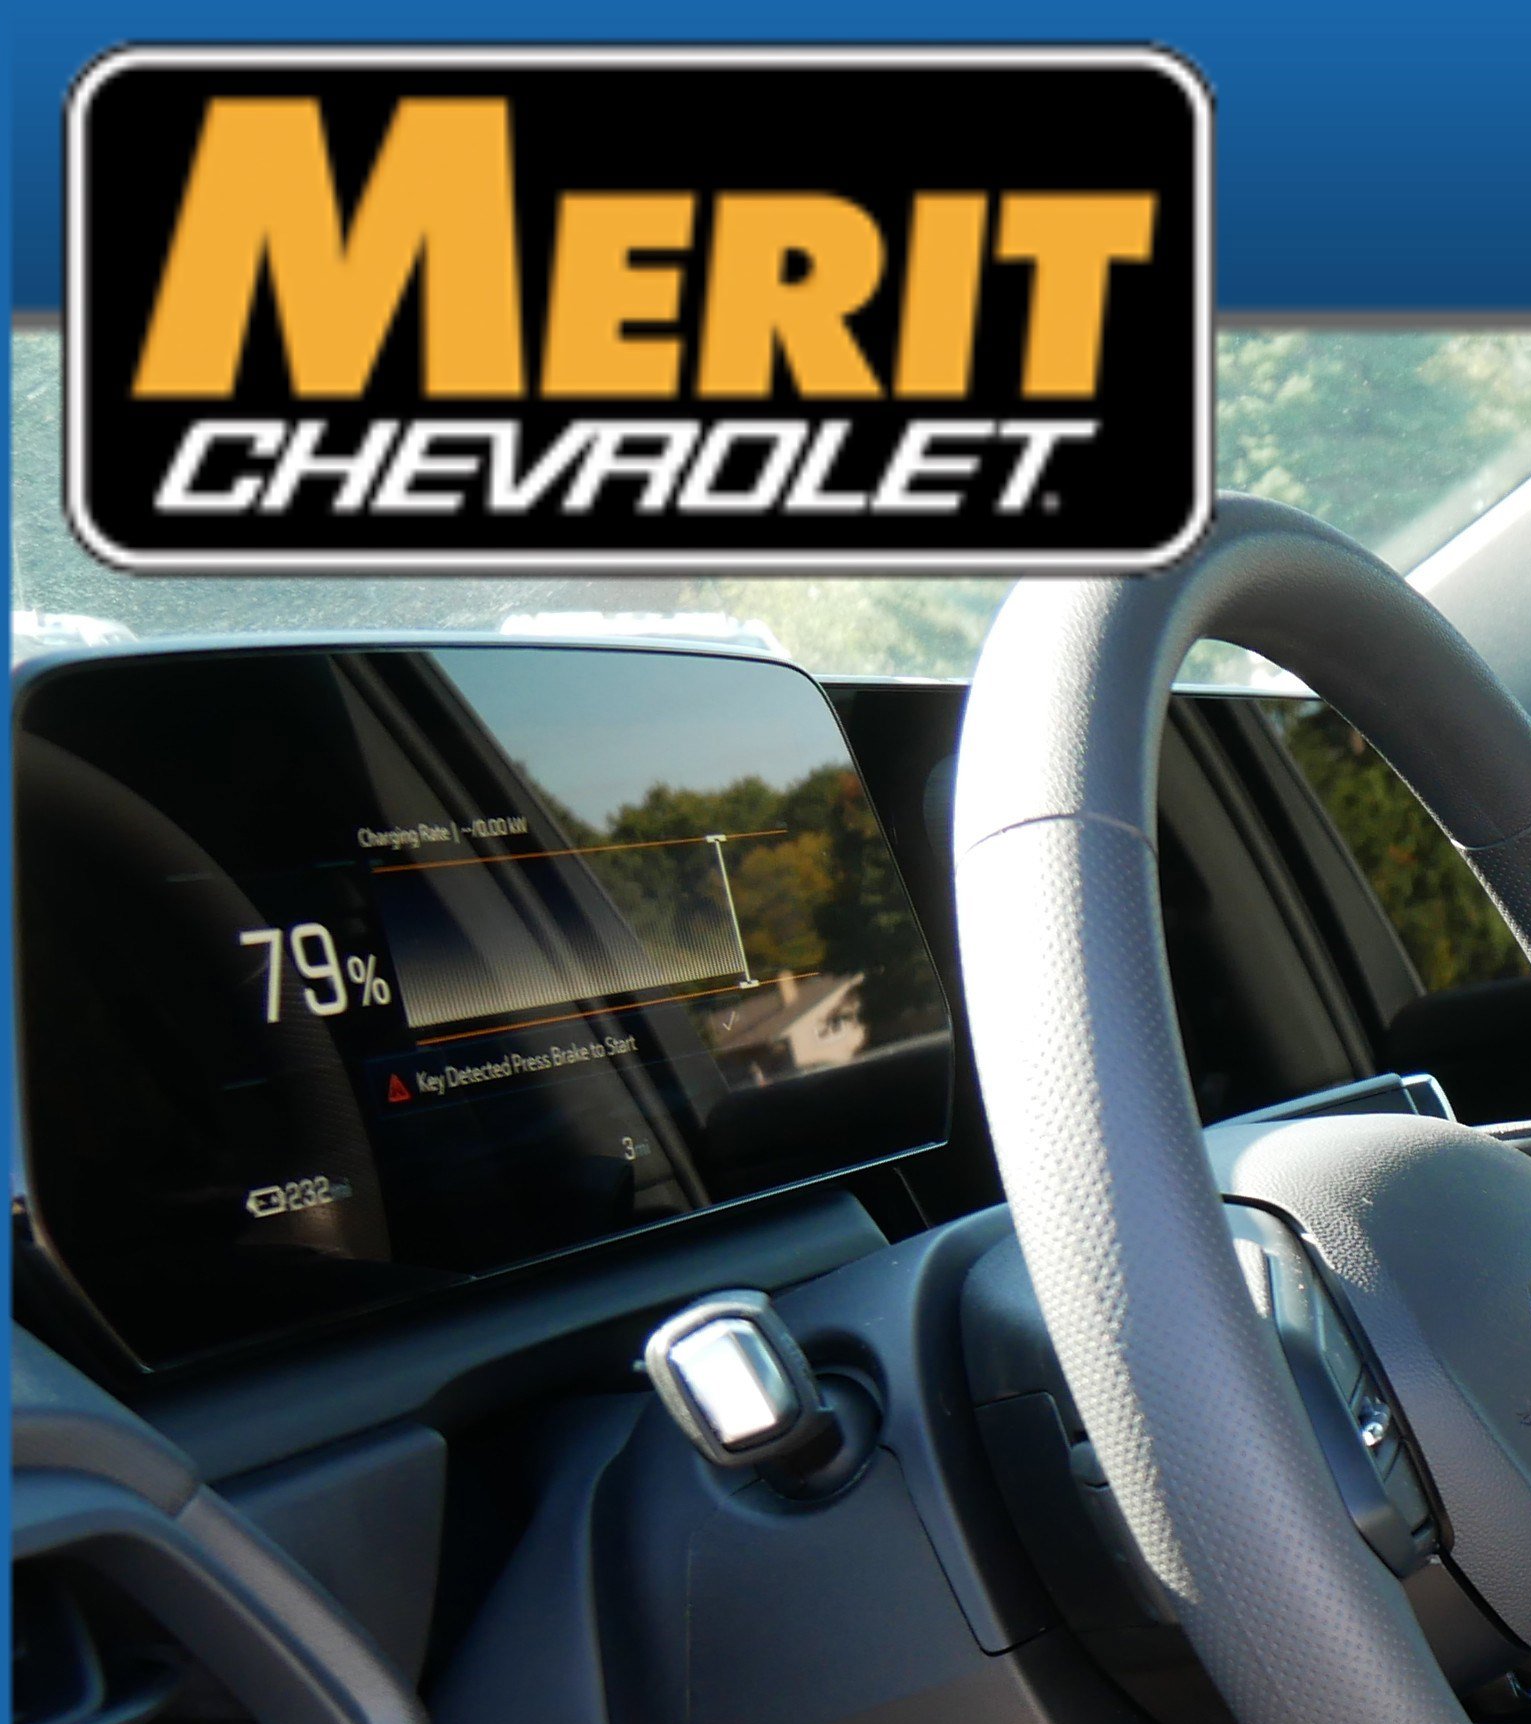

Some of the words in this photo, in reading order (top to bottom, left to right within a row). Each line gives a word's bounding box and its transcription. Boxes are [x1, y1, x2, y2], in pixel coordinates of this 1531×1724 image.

[357, 828, 420, 850] Charging
[416, 1070, 446, 1095] Key
[446, 1056, 512, 1088] Detected
[512, 1053, 551, 1074] Press
[552, 1043, 588, 1067] Brake
[589, 1042, 605, 1058] to
[605, 1034, 639, 1056] Start
